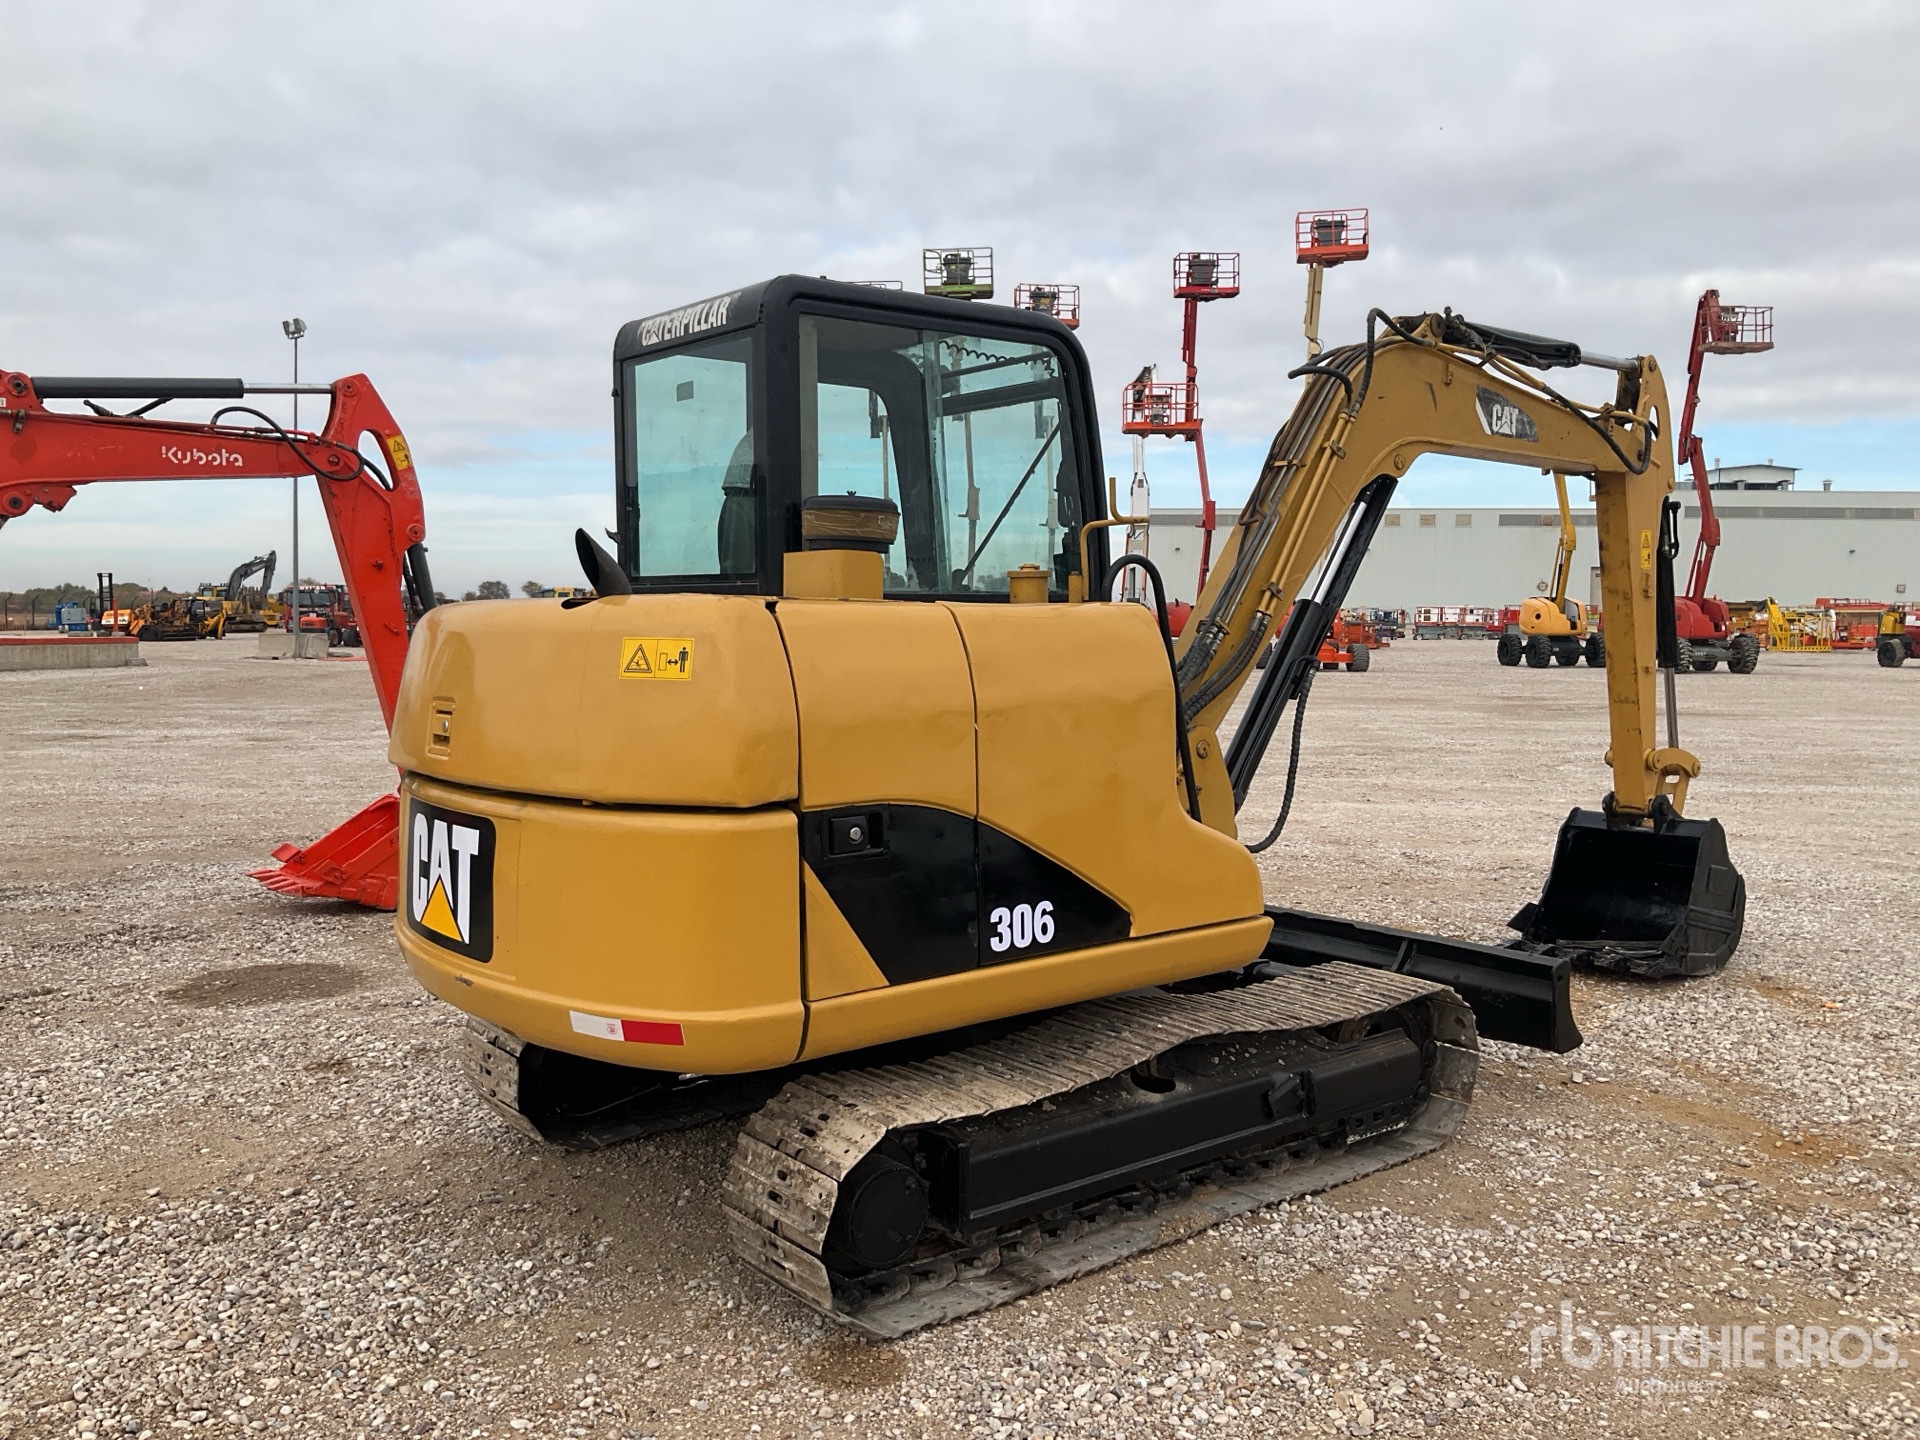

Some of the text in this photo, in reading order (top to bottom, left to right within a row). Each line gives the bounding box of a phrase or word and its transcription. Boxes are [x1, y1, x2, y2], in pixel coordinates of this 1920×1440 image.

[640, 295, 731, 347] CATERPILLAR
[1492, 404, 1519, 438] CAT
[161, 445, 244, 467] Kubota
[412, 812, 480, 945] CAT
[989, 900, 1055, 952] 306
